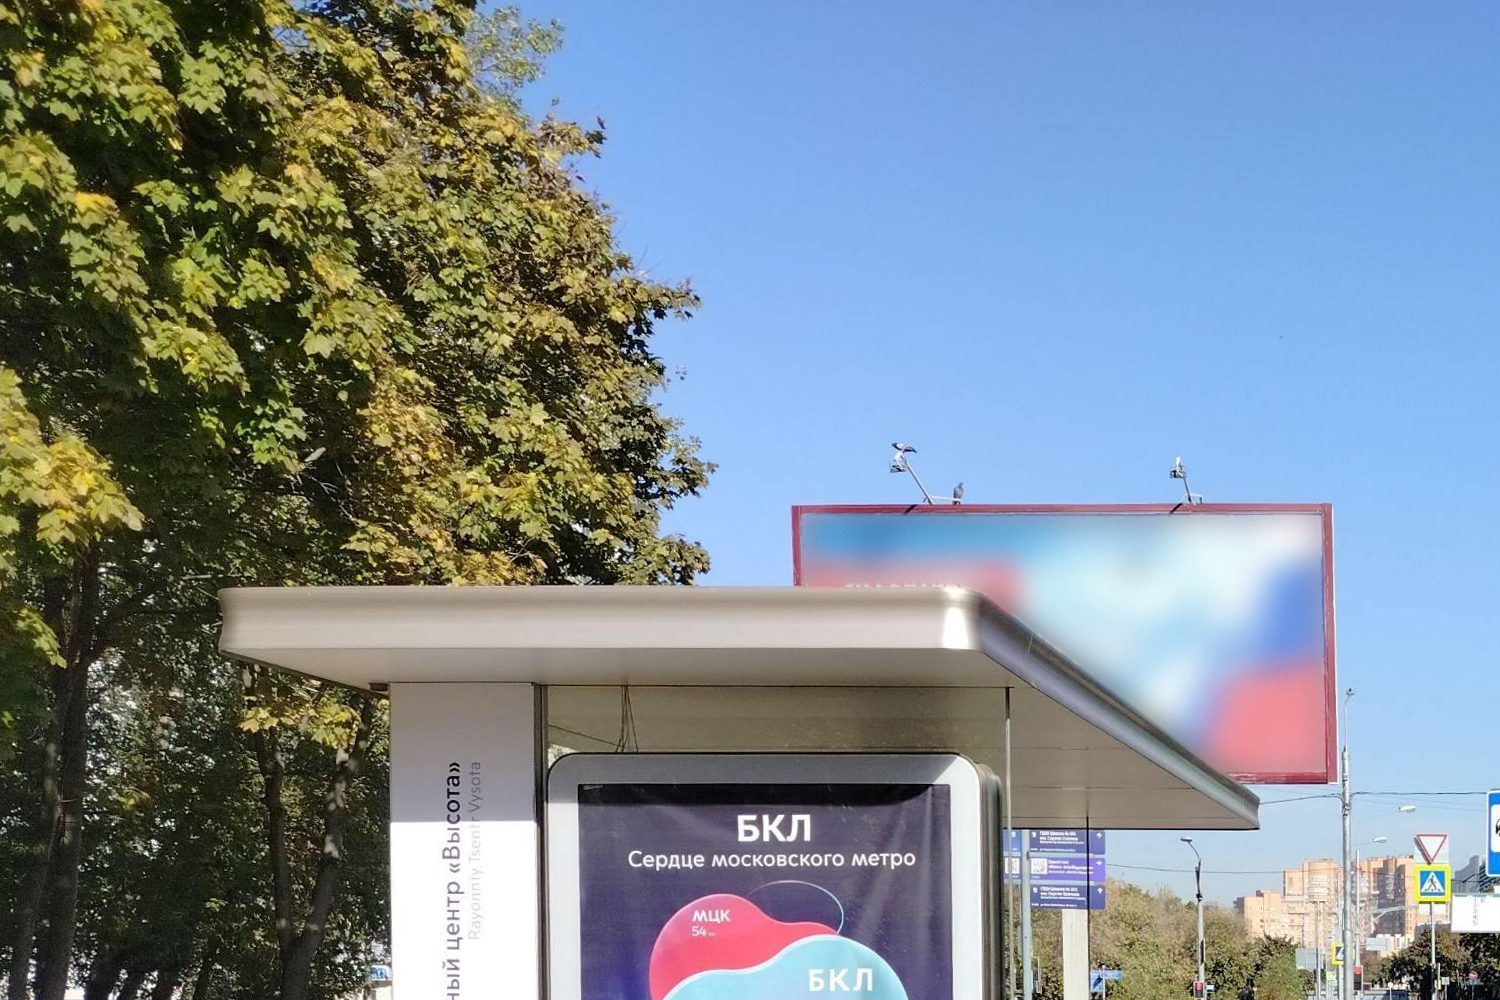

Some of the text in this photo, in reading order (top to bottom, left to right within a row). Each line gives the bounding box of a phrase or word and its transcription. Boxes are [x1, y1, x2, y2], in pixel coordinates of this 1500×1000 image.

[442, 761, 461, 873] «Высота»
[736, 813, 812, 842] БКЛ
[468, 761, 483, 941] Rayonniy Tsentr Vysota
[628, 850, 916, 871] Сердце московского метро
[446, 881, 465, 951] центр
[692, 909, 731, 924] МЦК
[691, 925, 707, 937] 54
[808, 967, 873, 992] БКЛ
